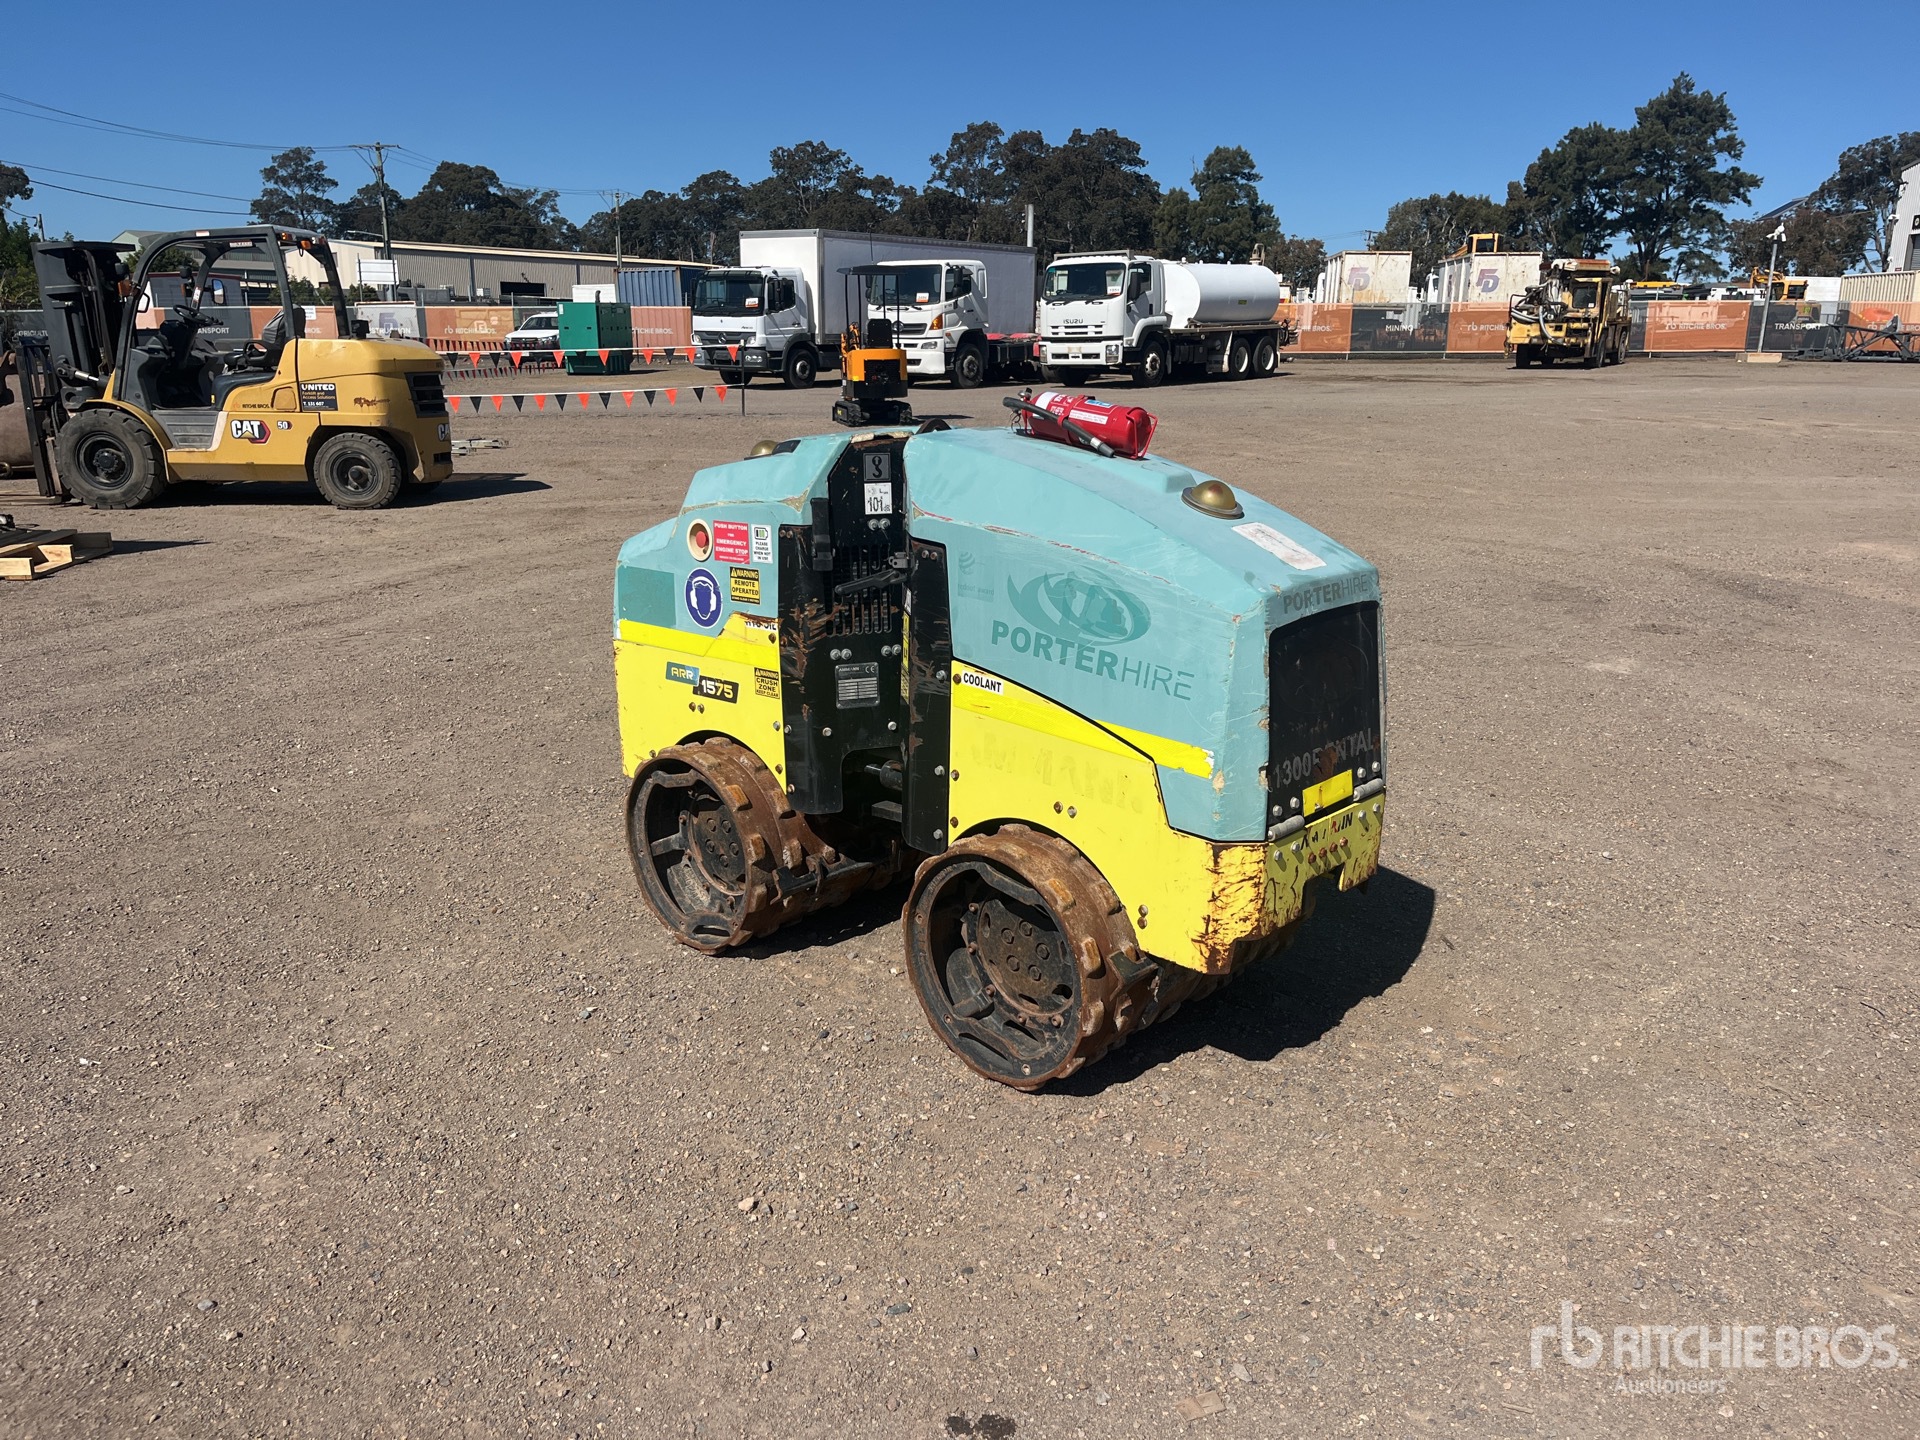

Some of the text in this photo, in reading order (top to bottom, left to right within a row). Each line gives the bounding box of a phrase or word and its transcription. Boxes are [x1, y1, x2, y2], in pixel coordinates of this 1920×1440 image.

[1385, 324, 1413, 332] MINING
[301, 383, 335, 391] UNITED
[231, 420, 288, 439] CAT 50
[728, 523, 748, 531] BUTTON
[716, 538, 747, 547] EMERGENCY
[736, 569, 759, 579] WARNING
[734, 579, 755, 588] REMOTE
[731, 587, 759, 596] OPERATED
[671, 667, 694, 680] ARR
[760, 670, 779, 679] WARNING
[756, 677, 778, 687] CRUSH
[963, 672, 1002, 693] COOLANT
[701, 679, 734, 699] 1575
[758, 683, 776, 692] ZONE
